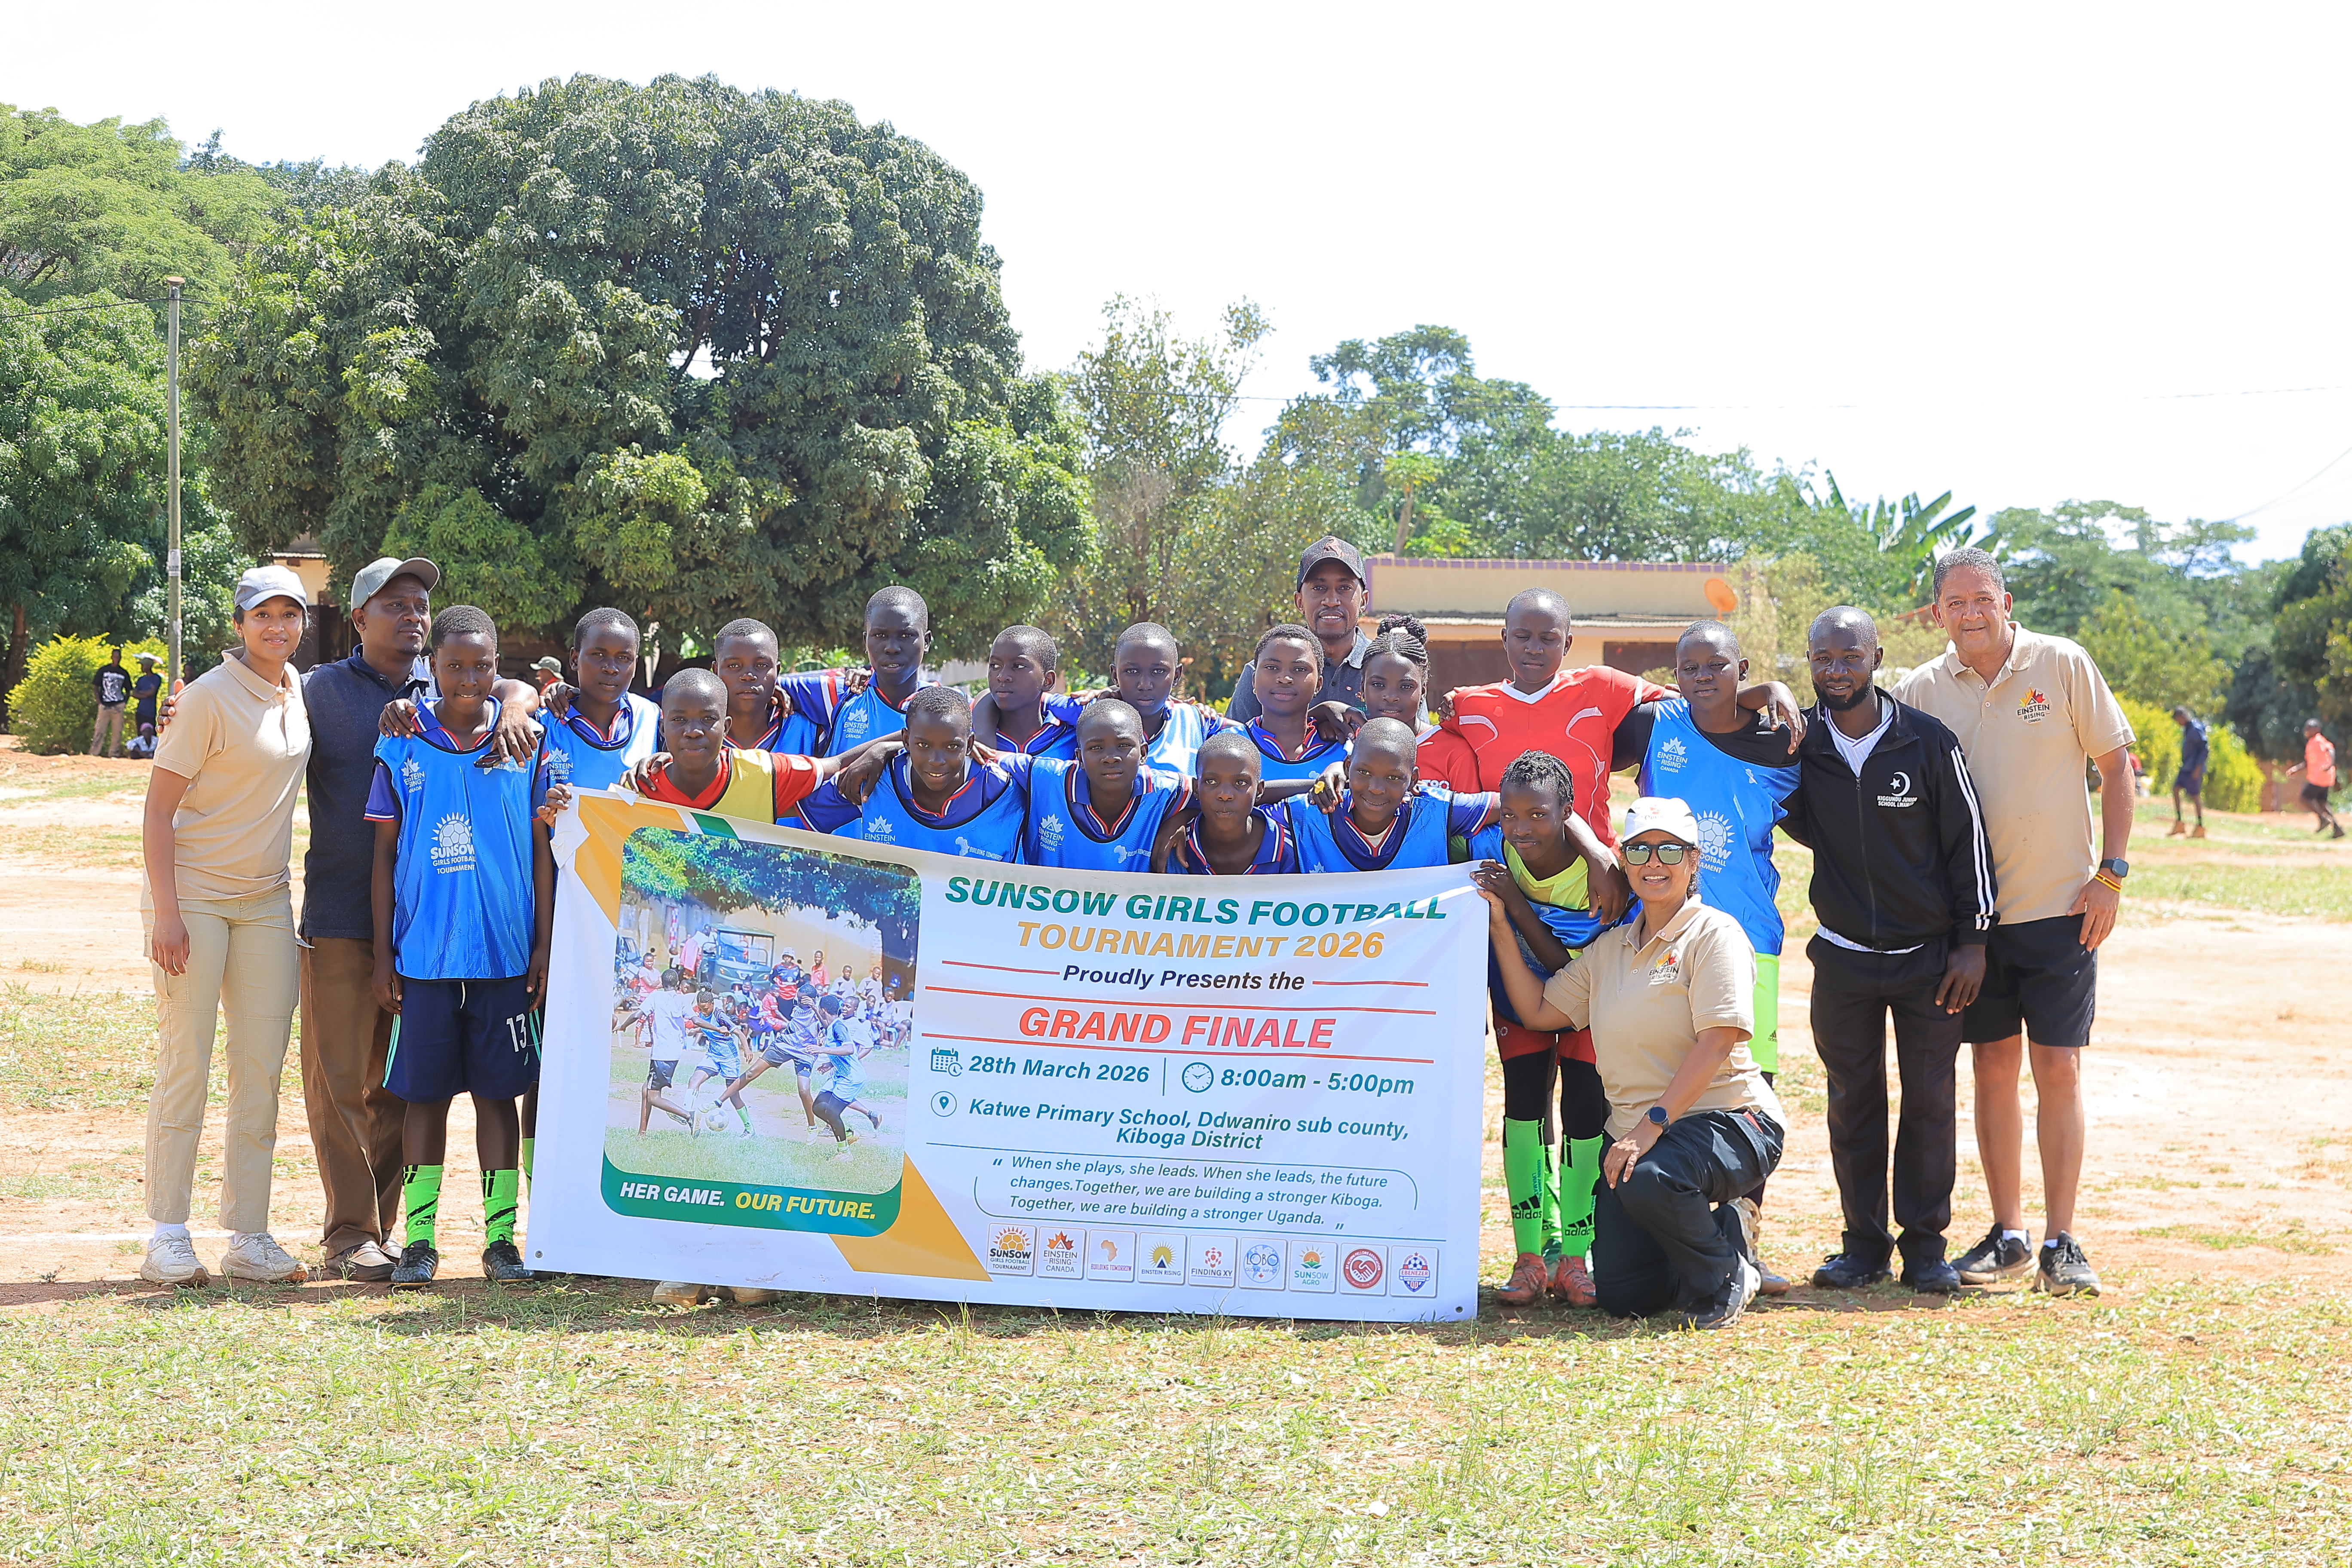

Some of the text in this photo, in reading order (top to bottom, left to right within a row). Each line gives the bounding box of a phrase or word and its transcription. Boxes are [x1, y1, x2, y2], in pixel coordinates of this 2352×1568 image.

[2017, 704, 2050, 716] EINSTEIN
[2024, 712, 2045, 720] RISING
[1657, 751, 1688, 764] EINSTEIN
[1661, 759, 1681, 769] RISING
[864, 833, 896, 842] EINSTEIN
[1038, 827, 1064, 841] EINSTEIN
[1040, 836, 1058, 846] RISING
[1040, 842, 1055, 851] CANADA
[437, 864, 475, 874] TOURNAMENT
[945, 876, 1447, 927] SUNSOW GIRLS FOOTBALL
[1018, 922, 1384, 958] TOURNAMENT 2026
[1063, 965, 1305, 990] Proudly Presents the
[506, 1013, 527, 1052] 13
[1019, 1007, 1336, 1049] GRAND FINALE
[968, 1055, 1150, 1082] 28th March 2026
[1221, 1069, 1306, 1088] 8:00am
[1327, 1072, 1414, 1097] 5:00pm
[969, 1099, 1408, 1141] Katwe Primary School, Ddwaniro sub county,
[1116, 1127, 1263, 1149] Kiboga District
[1013, 1156, 1052, 1170] When
[1055, 1158, 1081, 1171] she
[1084, 1160, 1125, 1176] plays,
[1129, 1162, 1155, 1176] she
[1158, 1163, 1198, 1178] leads.
[1204, 1166, 1242, 1180] When
[1246, 1168, 1271, 1181] she
[1274, 1169, 1316, 1185] leads,
[1320, 1172, 1342, 1185] the
[1346, 1173, 1387, 1188] future
[620, 1182, 876, 1219] HER GAME. OUR FUTURE.
[1010, 1175, 1382, 1210] changes.Together, we are building a stronger Kiboga.
[1011, 1195, 1324, 1225] Together, we are building a stronger Uganda.
[990, 1248, 1032, 1259] SUNSOW
[1044, 1250, 1078, 1259] EINSTEIN
[1246, 1253, 1279, 1266] LOBO
[1294, 1270, 1329, 1280] SUNSOW
